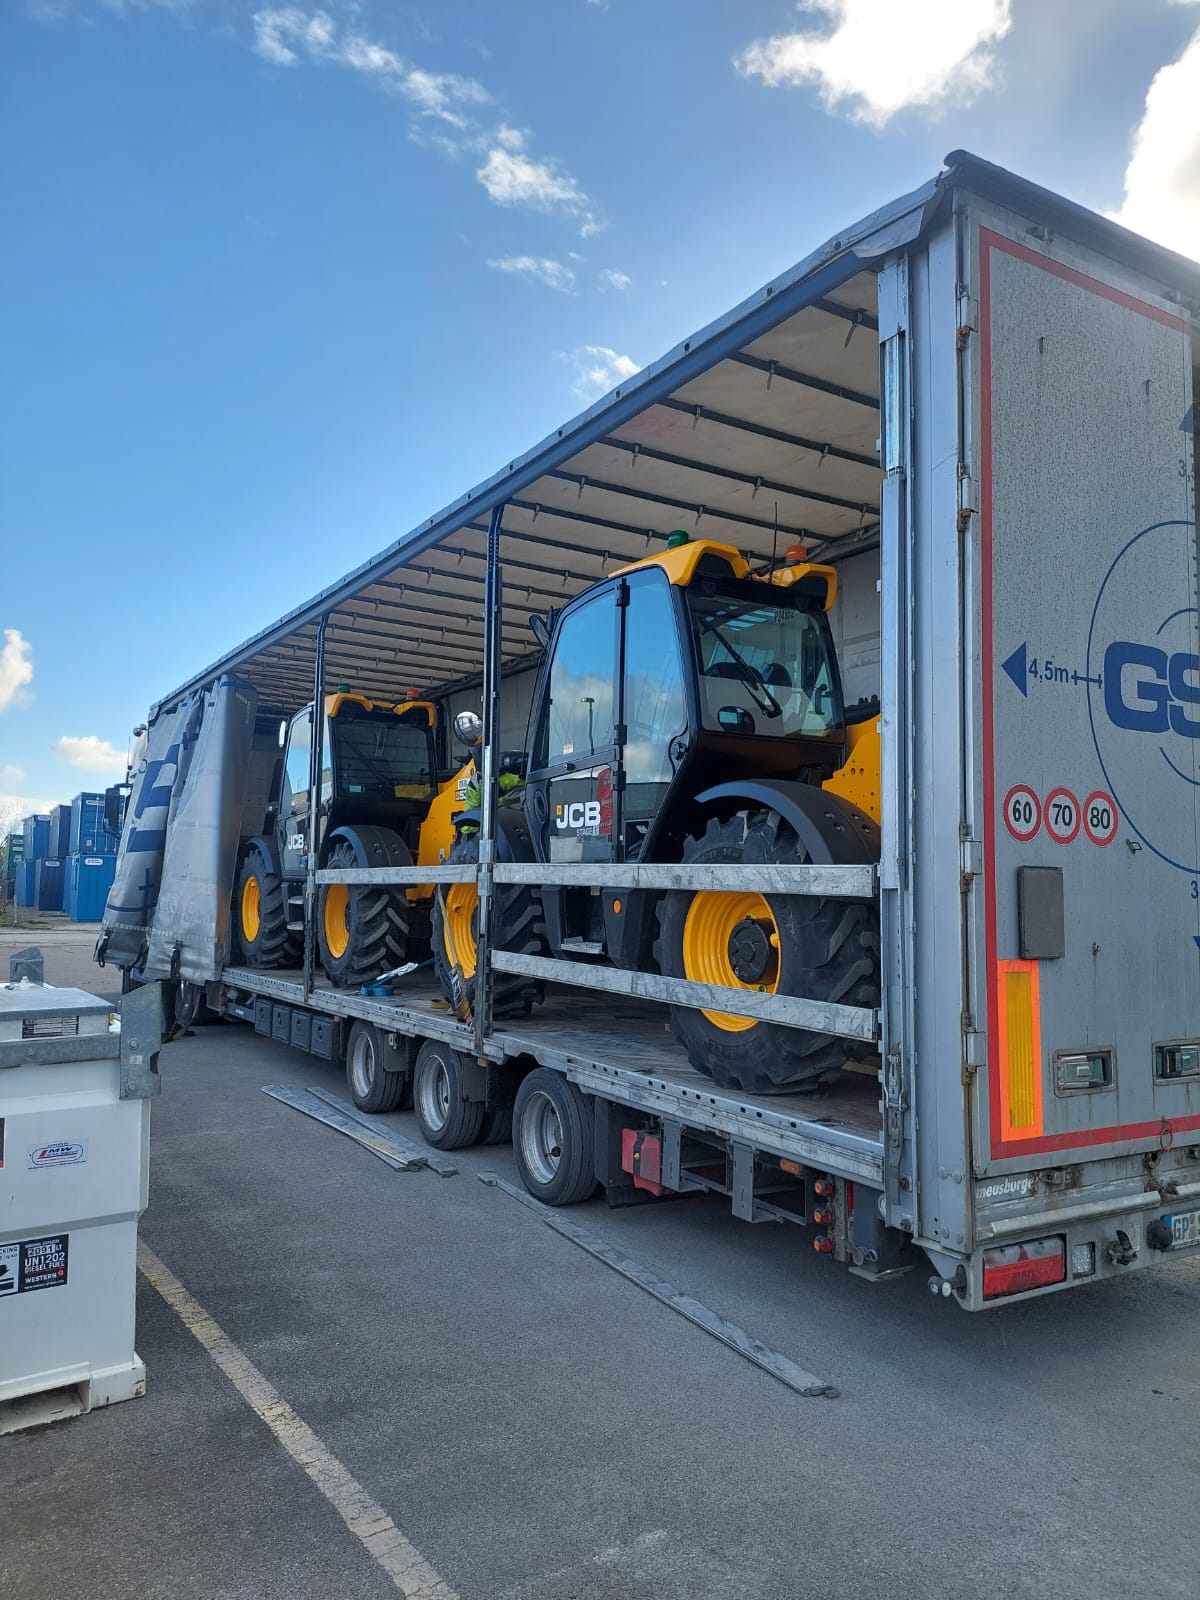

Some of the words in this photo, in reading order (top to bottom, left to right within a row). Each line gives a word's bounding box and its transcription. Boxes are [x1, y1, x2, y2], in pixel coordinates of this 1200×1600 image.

[1028, 658, 1069, 683] 4,5m
[556, 801, 600, 829] JCB
[1012, 799, 1033, 824] 60
[1052, 803, 1073, 827] 70
[1090, 806, 1111, 830] 80
[288, 833, 304, 850] JCB
[25, 1252, 65, 1267] UN1202
[25, 1263, 47, 1274] DIESEL
[49, 1260, 65, 1269] FUEL
[25, 1272, 57, 1283] WESTERN
